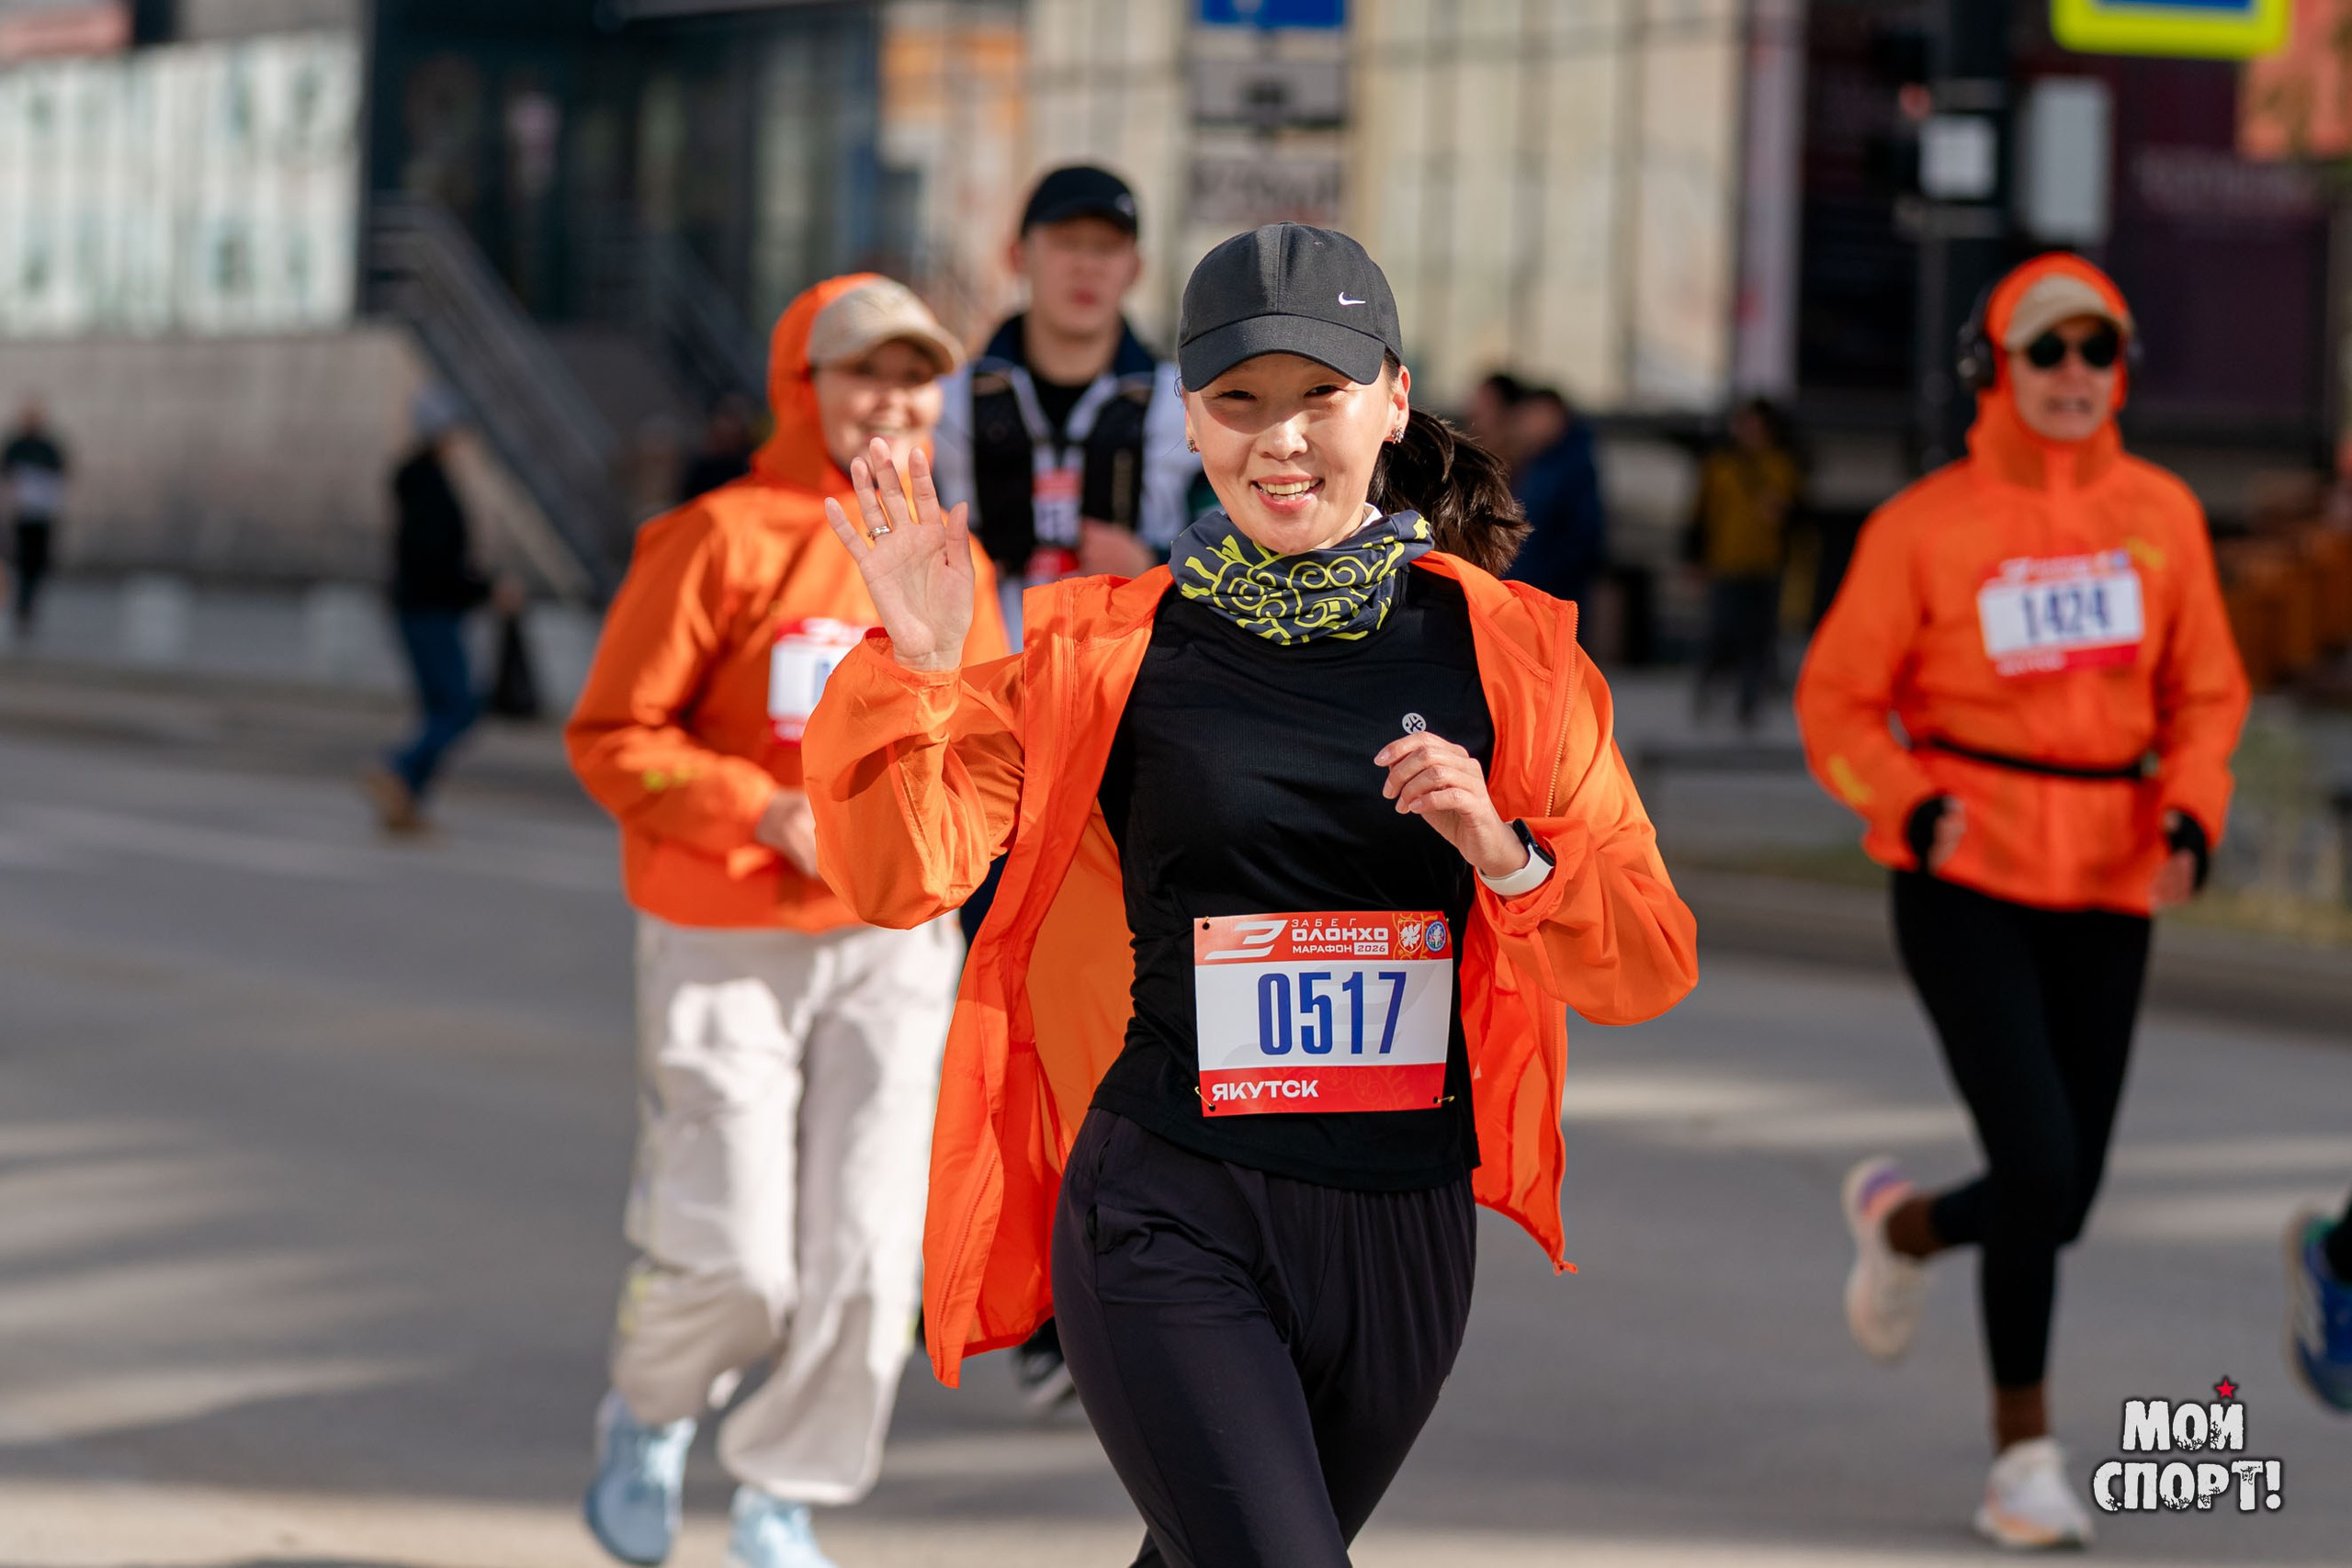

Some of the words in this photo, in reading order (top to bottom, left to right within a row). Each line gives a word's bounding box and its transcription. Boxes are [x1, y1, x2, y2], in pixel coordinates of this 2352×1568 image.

[2021, 582, 2111, 645] 1424
[1291, 919, 1357, 928] ЗАБЕГ
[1292, 928, 1389, 942] ОЛОНХО
[1292, 944, 1352, 953] МАРАФОН
[1357, 944, 1385, 953] 2026
[1258, 971, 1407, 1055] 0517
[1211, 1079, 1319, 1101] ЯКУТСК
